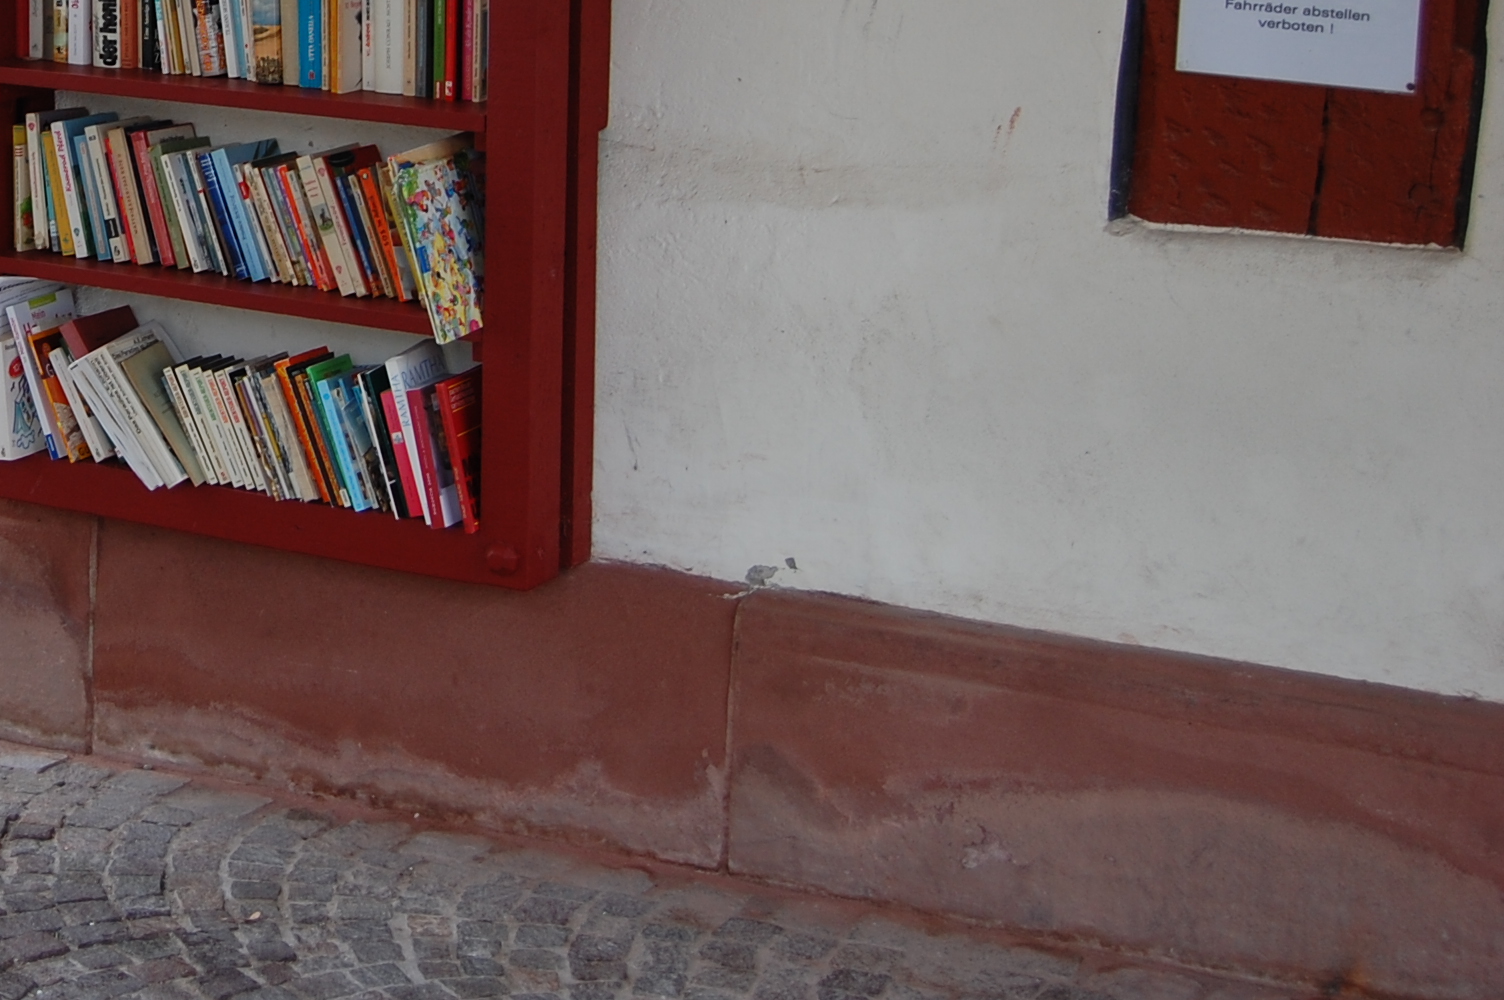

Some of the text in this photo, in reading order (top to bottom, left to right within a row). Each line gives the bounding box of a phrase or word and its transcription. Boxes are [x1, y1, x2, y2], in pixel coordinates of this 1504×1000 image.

[1258, 18, 1325, 34] verboten
[1302, 5, 1371, 22] abstellen
[99, 36, 117, 66] der
[401, 354, 445, 389] RAMTHA
[390, 372, 411, 428] RAMTHA
